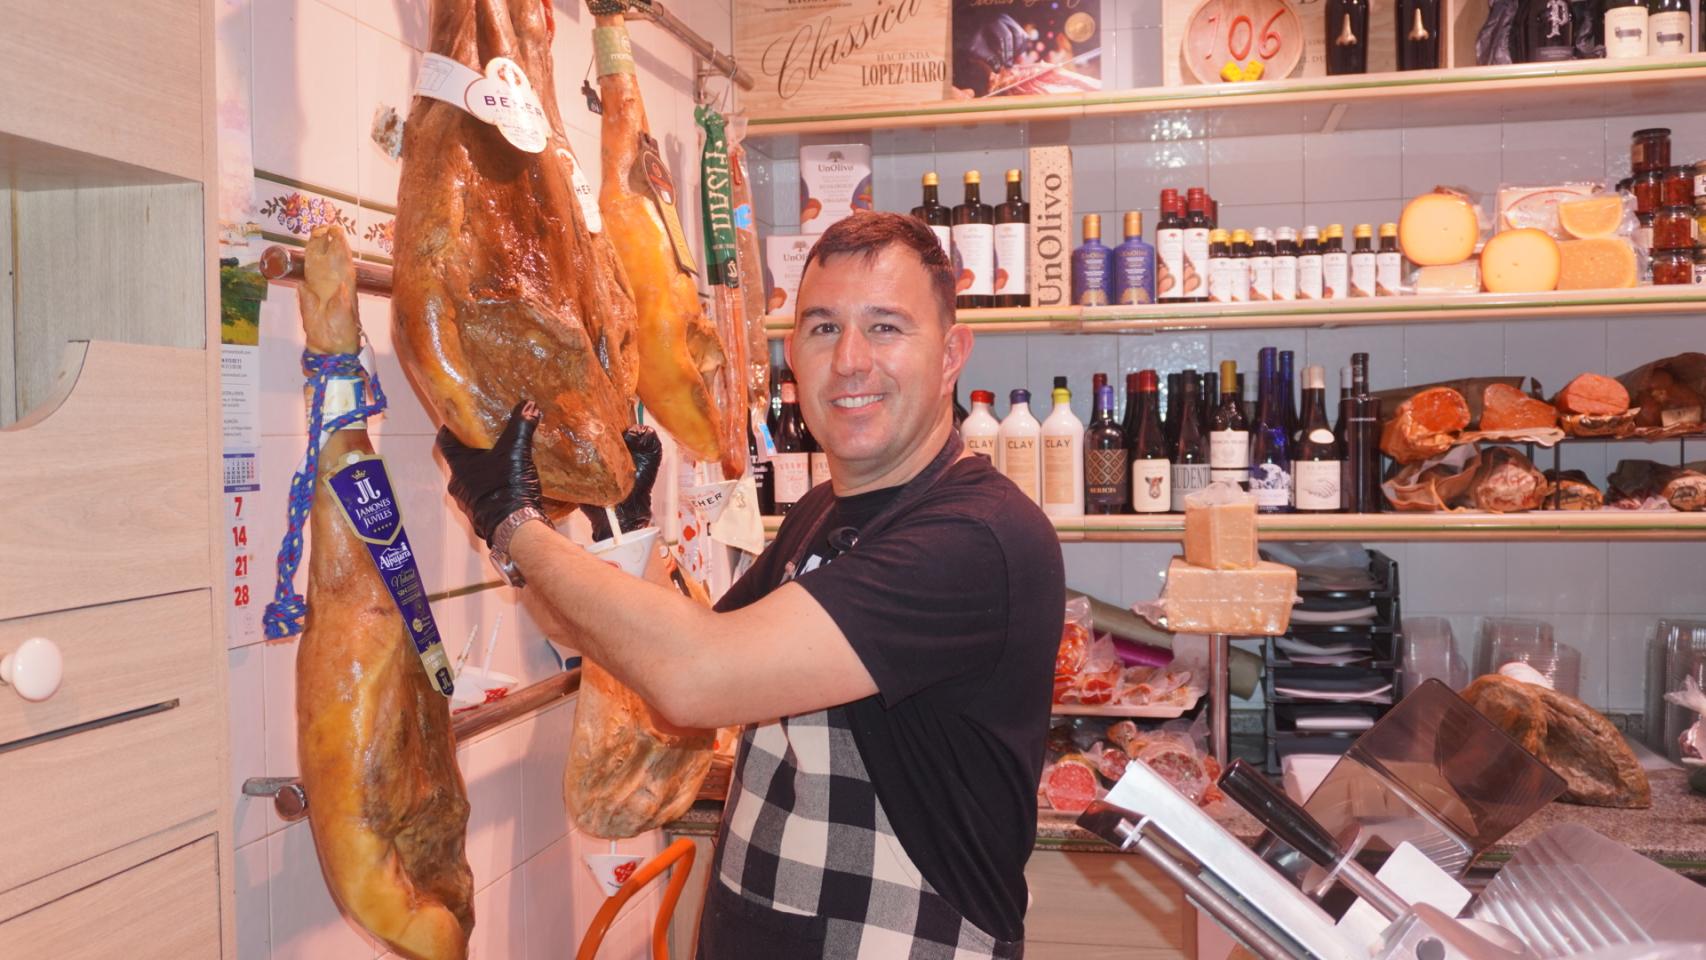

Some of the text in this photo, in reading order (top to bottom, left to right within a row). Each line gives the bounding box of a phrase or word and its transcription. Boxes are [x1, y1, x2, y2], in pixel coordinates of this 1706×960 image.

[1205, 9, 1285, 60] 106
[876, 51, 930, 61] HACIENDA
[862, 61, 946, 86] LOPEZ HARO
[818, 163, 854, 172] UnOlivo
[1037, 173, 1063, 307] UnOlivo
[968, 440, 994, 449] CLAY
[1007, 440, 1034, 449] CLAY
[1045, 439, 1070, 448] CLAY
[234, 496, 243, 517] 7
[355, 498, 391, 520] JAMONES
[363, 509, 393, 529] JUVILES
[232, 526, 247, 547] 14
[235, 555, 248, 577] 21
[234, 584, 250, 607] 28
